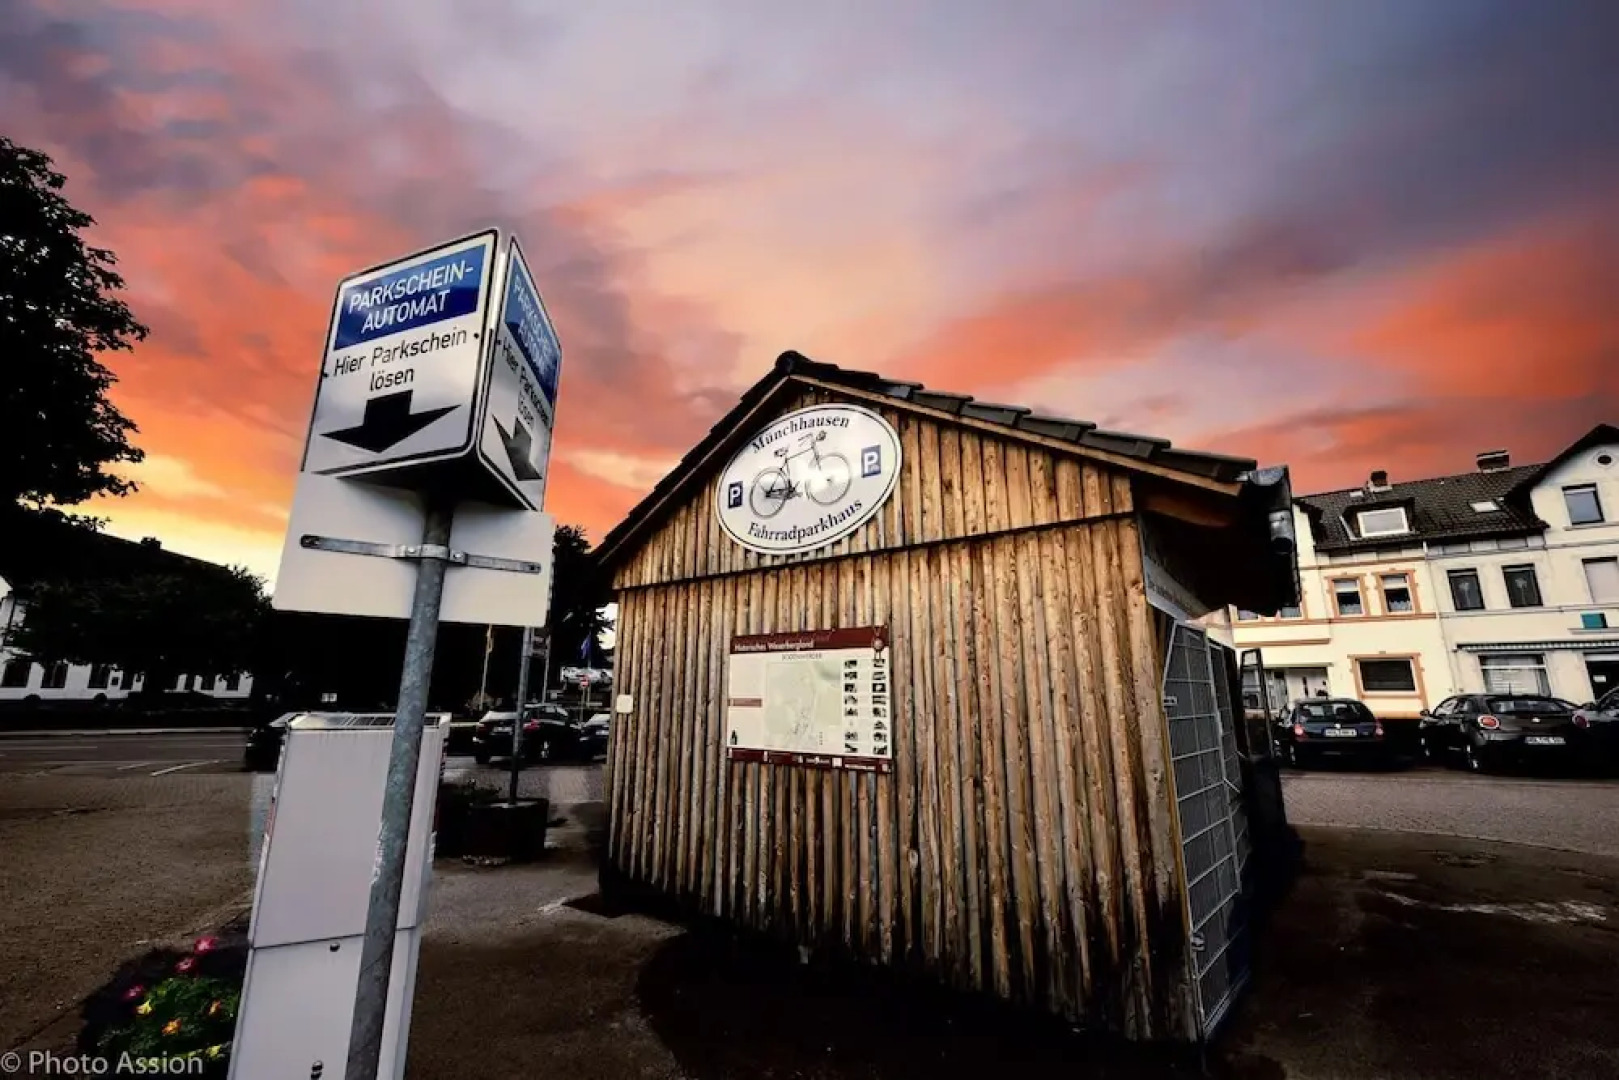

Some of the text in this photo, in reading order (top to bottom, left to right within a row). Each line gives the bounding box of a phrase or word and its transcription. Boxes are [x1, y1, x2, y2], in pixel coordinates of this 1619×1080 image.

[348, 260, 474, 314] PARKSCHEIN-
[361, 289, 451, 335] AUTOMAT
[334, 327, 467, 377] Hier Parkschein
[369, 368, 415, 392] lösen
[750, 415, 850, 454] Münchhausen
[863, 451, 878, 474] P
[729, 487, 741, 506] P
[747, 499, 863, 544] Fahrradparkhaus
